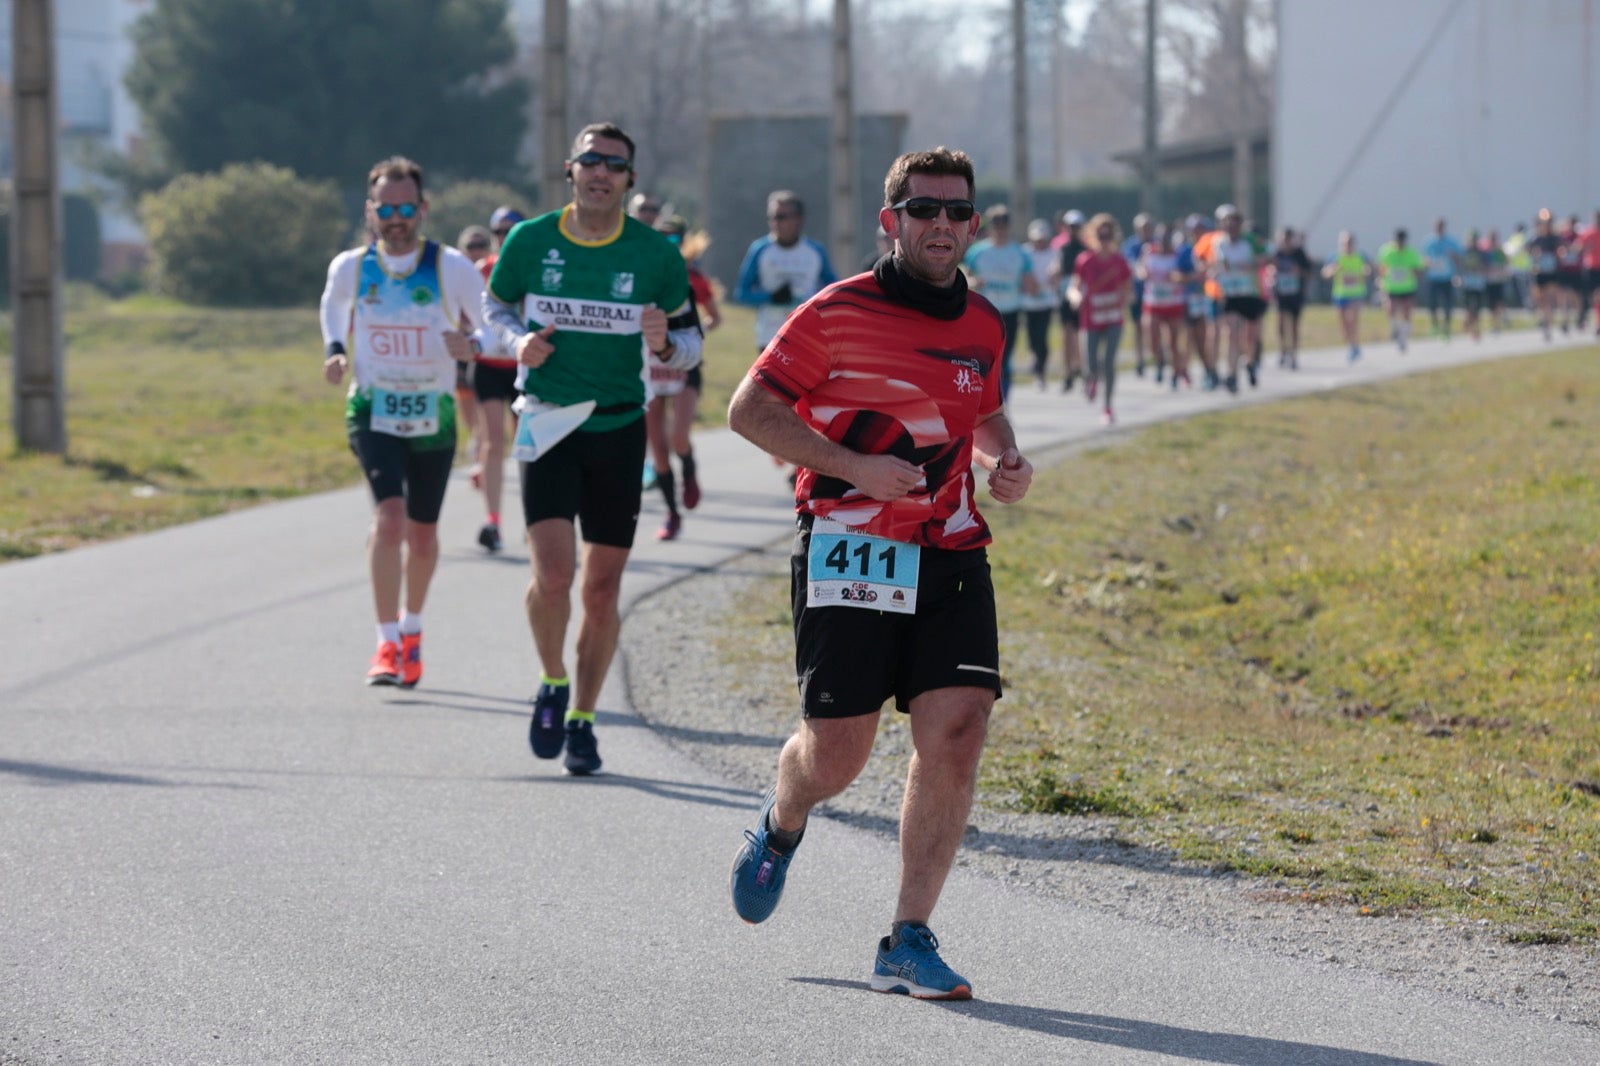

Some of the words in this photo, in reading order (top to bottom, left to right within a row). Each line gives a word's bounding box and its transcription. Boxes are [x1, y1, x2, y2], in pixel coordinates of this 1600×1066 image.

[581, 304, 634, 321] RURAL
[555, 317, 612, 329] GRANADA
[385, 393, 426, 417] 955
[826, 540, 896, 579] 411
[841, 588, 878, 602] 2020
